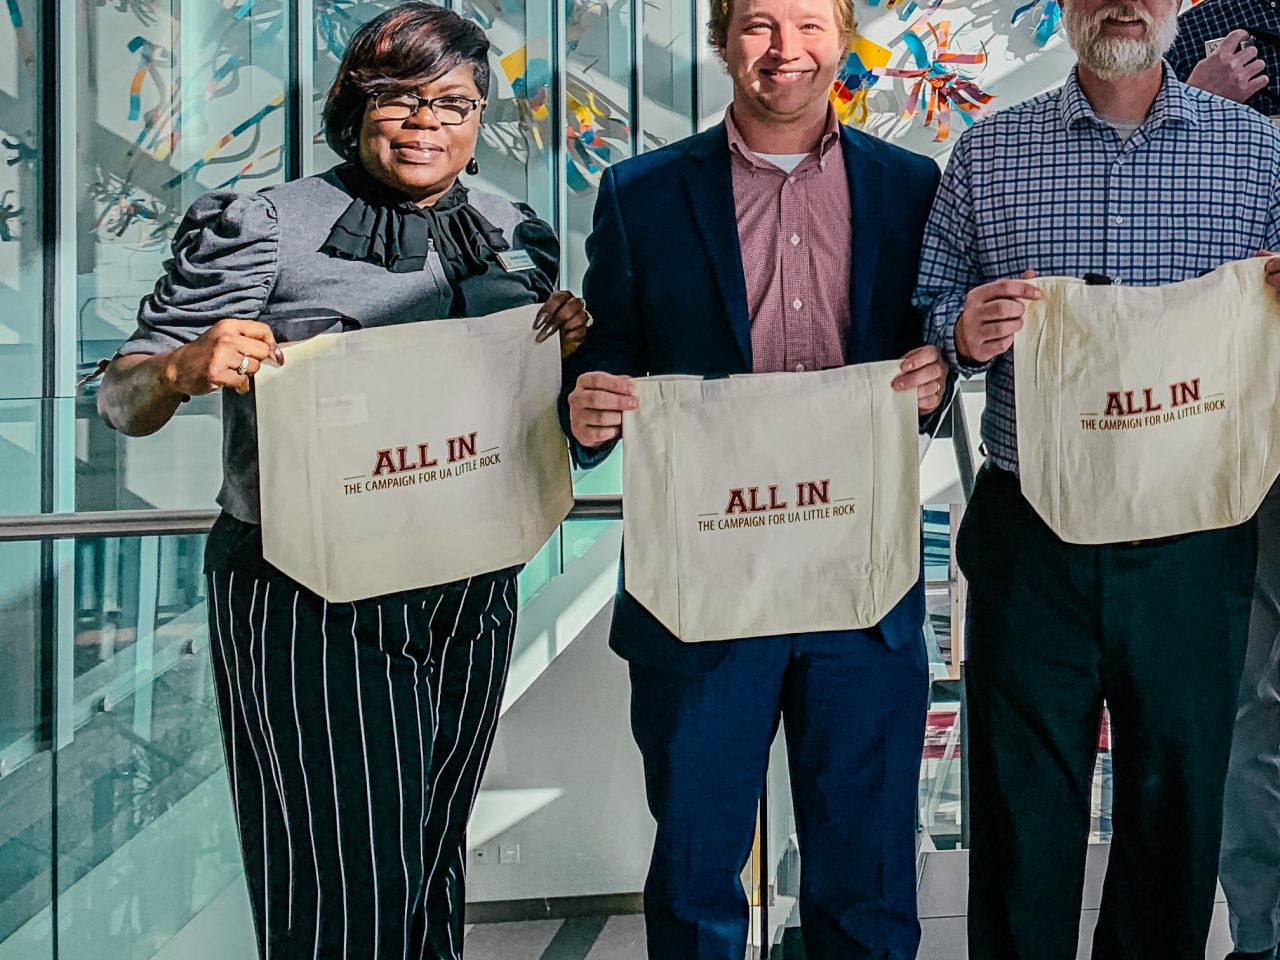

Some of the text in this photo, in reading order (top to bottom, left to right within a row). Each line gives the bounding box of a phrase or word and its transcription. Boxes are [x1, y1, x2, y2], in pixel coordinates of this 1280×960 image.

[1081, 399, 1226, 431] THE CAMPAIGN FOR UA LITTLE ROCK
[1104, 378, 1200, 416] ALL IN
[372, 432, 478, 475] ALL IN
[343, 453, 502, 496] THE CAMPAIGN FOR UA LITTLE ROCK
[725, 479, 830, 515] ALL IN
[697, 503, 856, 532] THE CAMPAIGN FOR UA LITTLE ROCK
